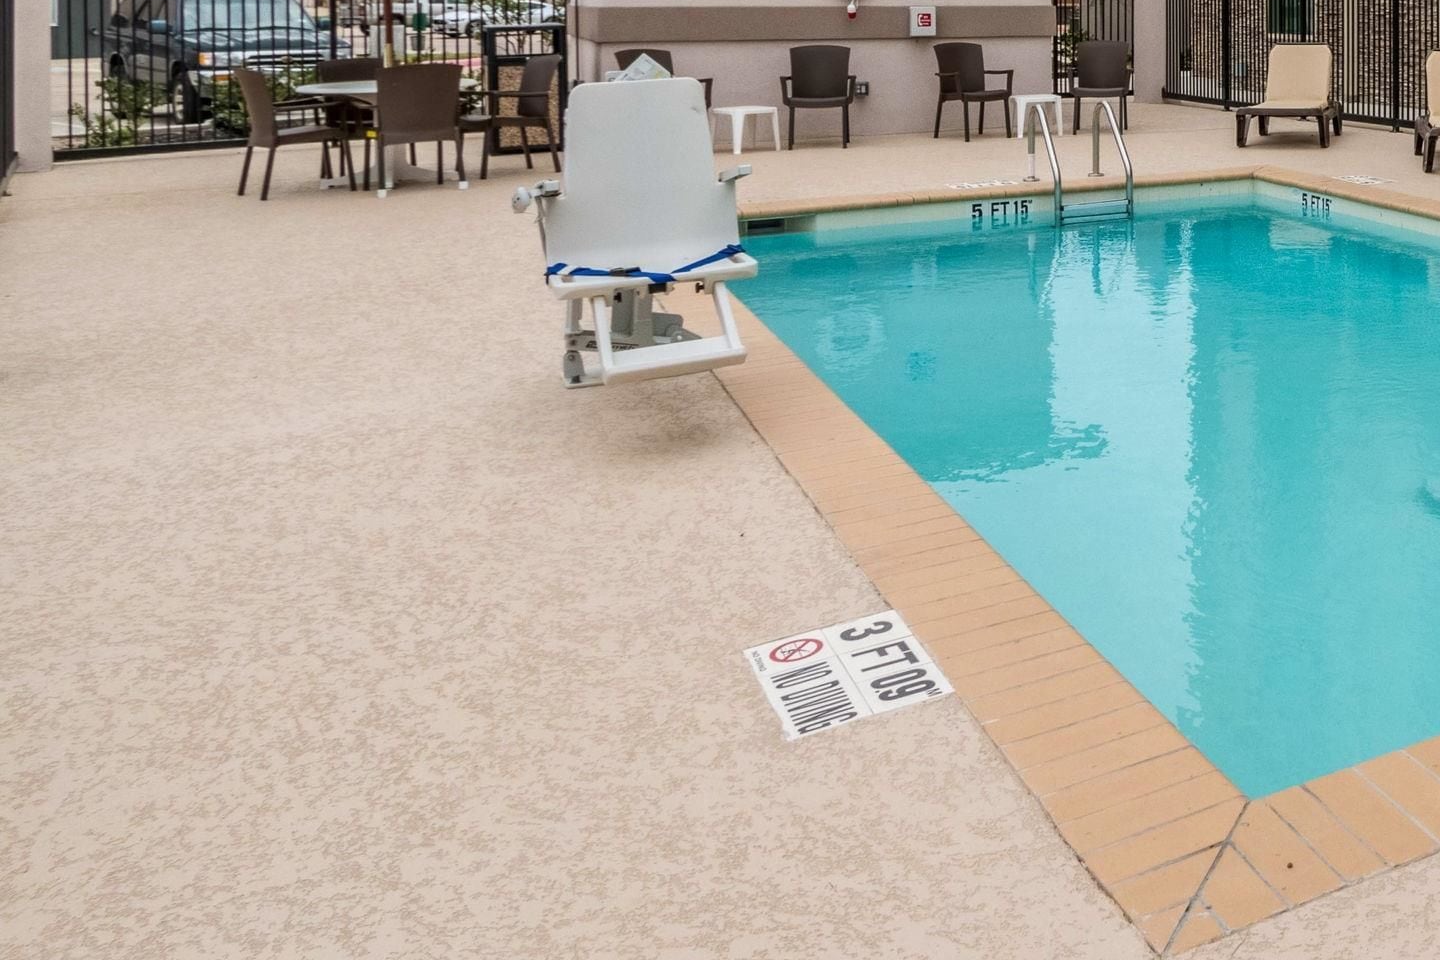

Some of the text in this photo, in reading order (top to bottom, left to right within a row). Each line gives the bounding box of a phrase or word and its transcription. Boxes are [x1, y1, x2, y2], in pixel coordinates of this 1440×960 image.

[972, 204, 982, 218] 5
[991, 201, 1010, 217] FT
[840, 620, 893, 641] 3
[851, 641, 919, 672] FT
[770, 661, 858, 734] NO DIVING
